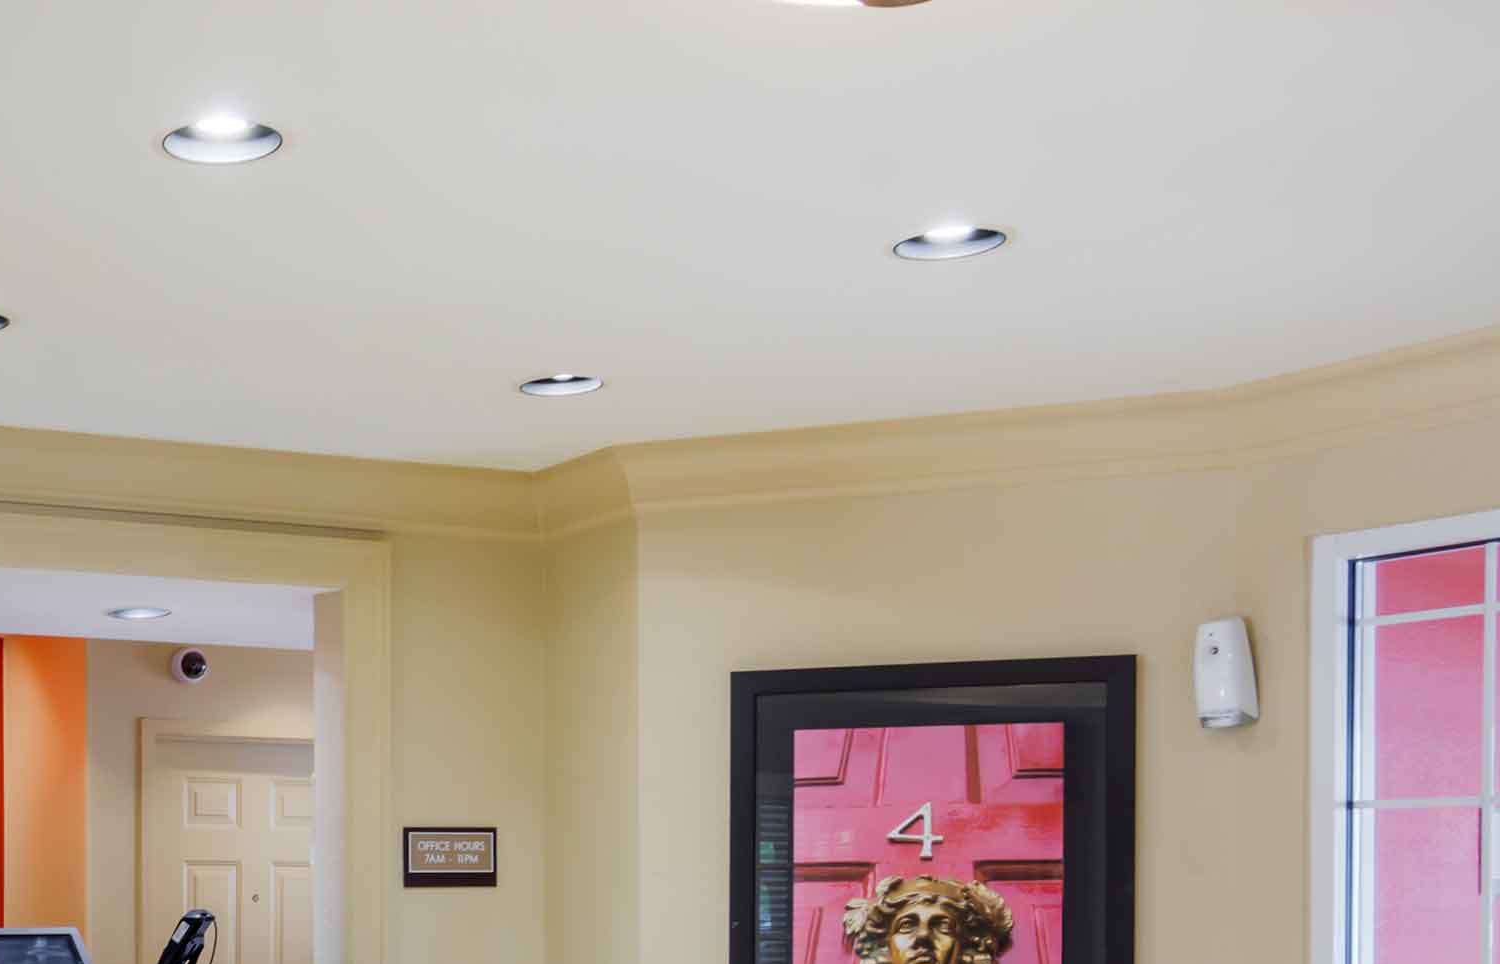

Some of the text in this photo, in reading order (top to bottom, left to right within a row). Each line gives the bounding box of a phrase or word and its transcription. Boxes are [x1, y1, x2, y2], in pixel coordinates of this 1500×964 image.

[418, 841, 485, 851] OFFICE HOURS
[885, 801, 945, 859] 4
